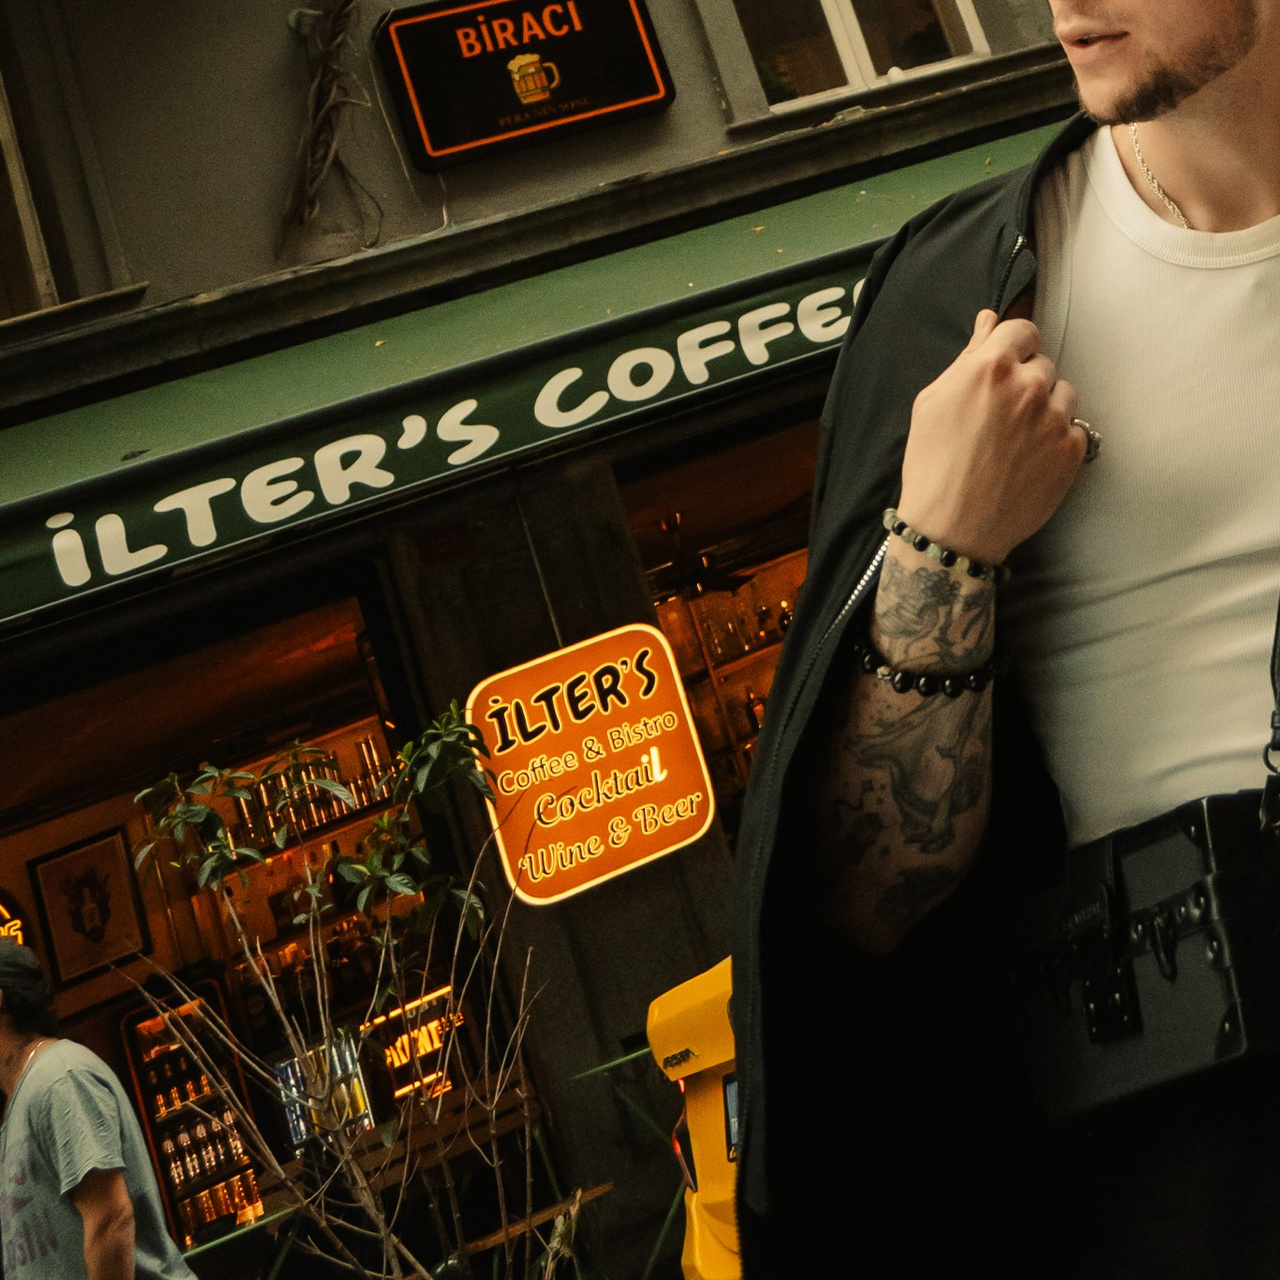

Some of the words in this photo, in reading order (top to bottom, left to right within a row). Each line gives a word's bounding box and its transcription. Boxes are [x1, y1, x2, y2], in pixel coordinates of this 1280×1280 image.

[46, 399, 500, 586] İLTER'S
[486, 647, 658, 755] İLTER'S
[497, 751, 578, 795] Coffee
[583, 737, 604, 762] &
[607, 711, 678, 752] Bistro
[534, 746, 667, 827] Cocktail
[519, 836, 604, 882] Wine
[609, 816, 631, 847] &
[633, 792, 703, 835] Beer
